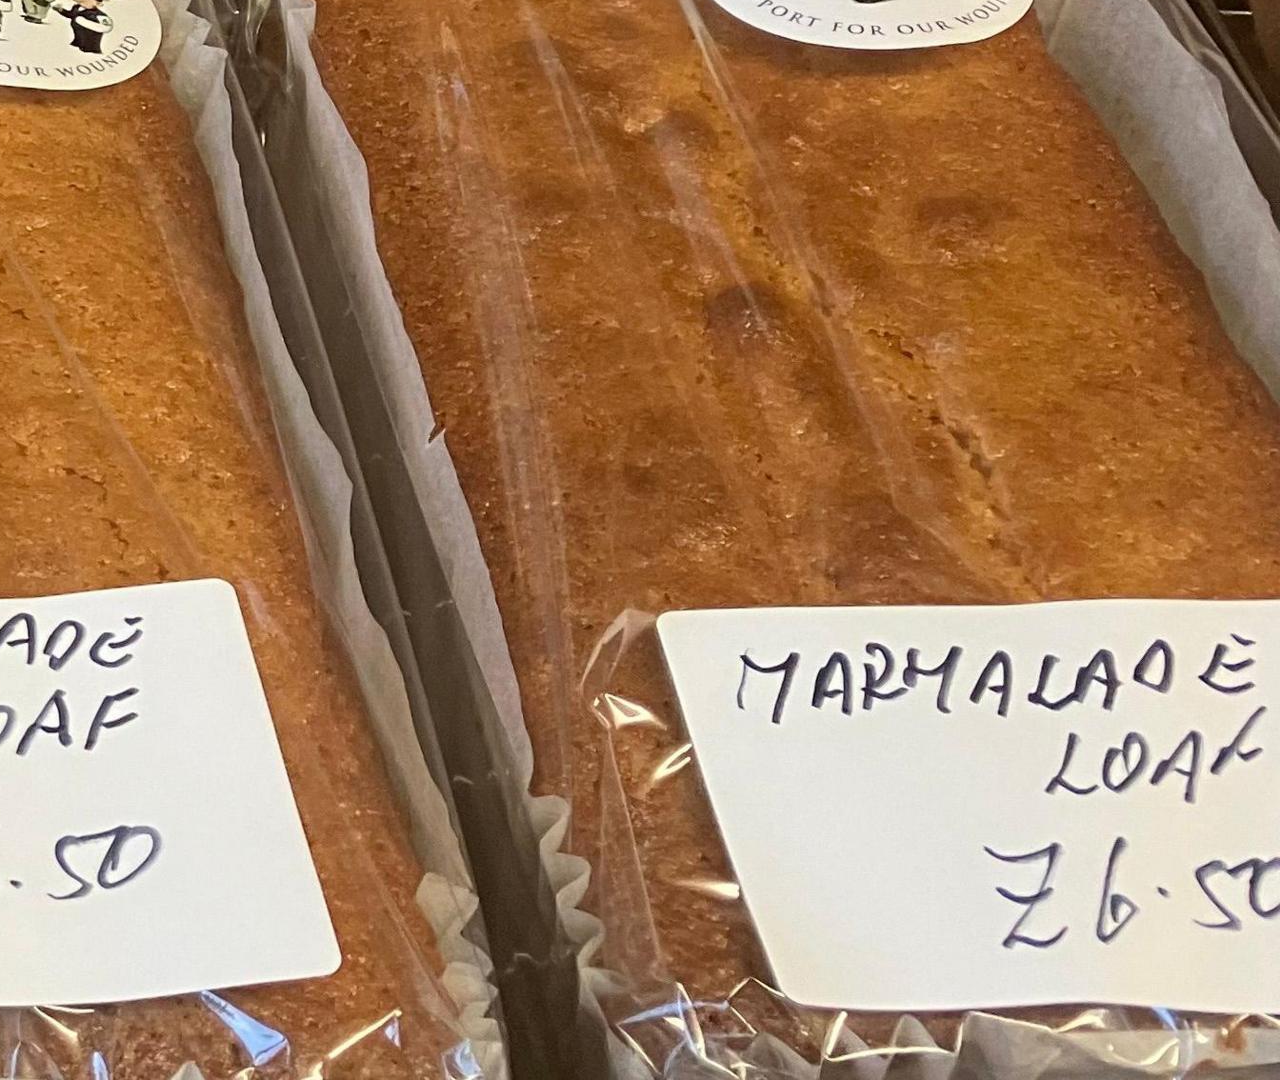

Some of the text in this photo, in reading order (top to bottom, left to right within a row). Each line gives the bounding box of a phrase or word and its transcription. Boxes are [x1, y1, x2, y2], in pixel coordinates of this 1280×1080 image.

[55, 34, 140, 78] WOUNDED
[832, 21, 886, 37] FOR
[896, 18, 954, 37] OUR
[738, 633, 1256, 724] MARMALADE
[1044, 706, 1266, 804] LOAF
